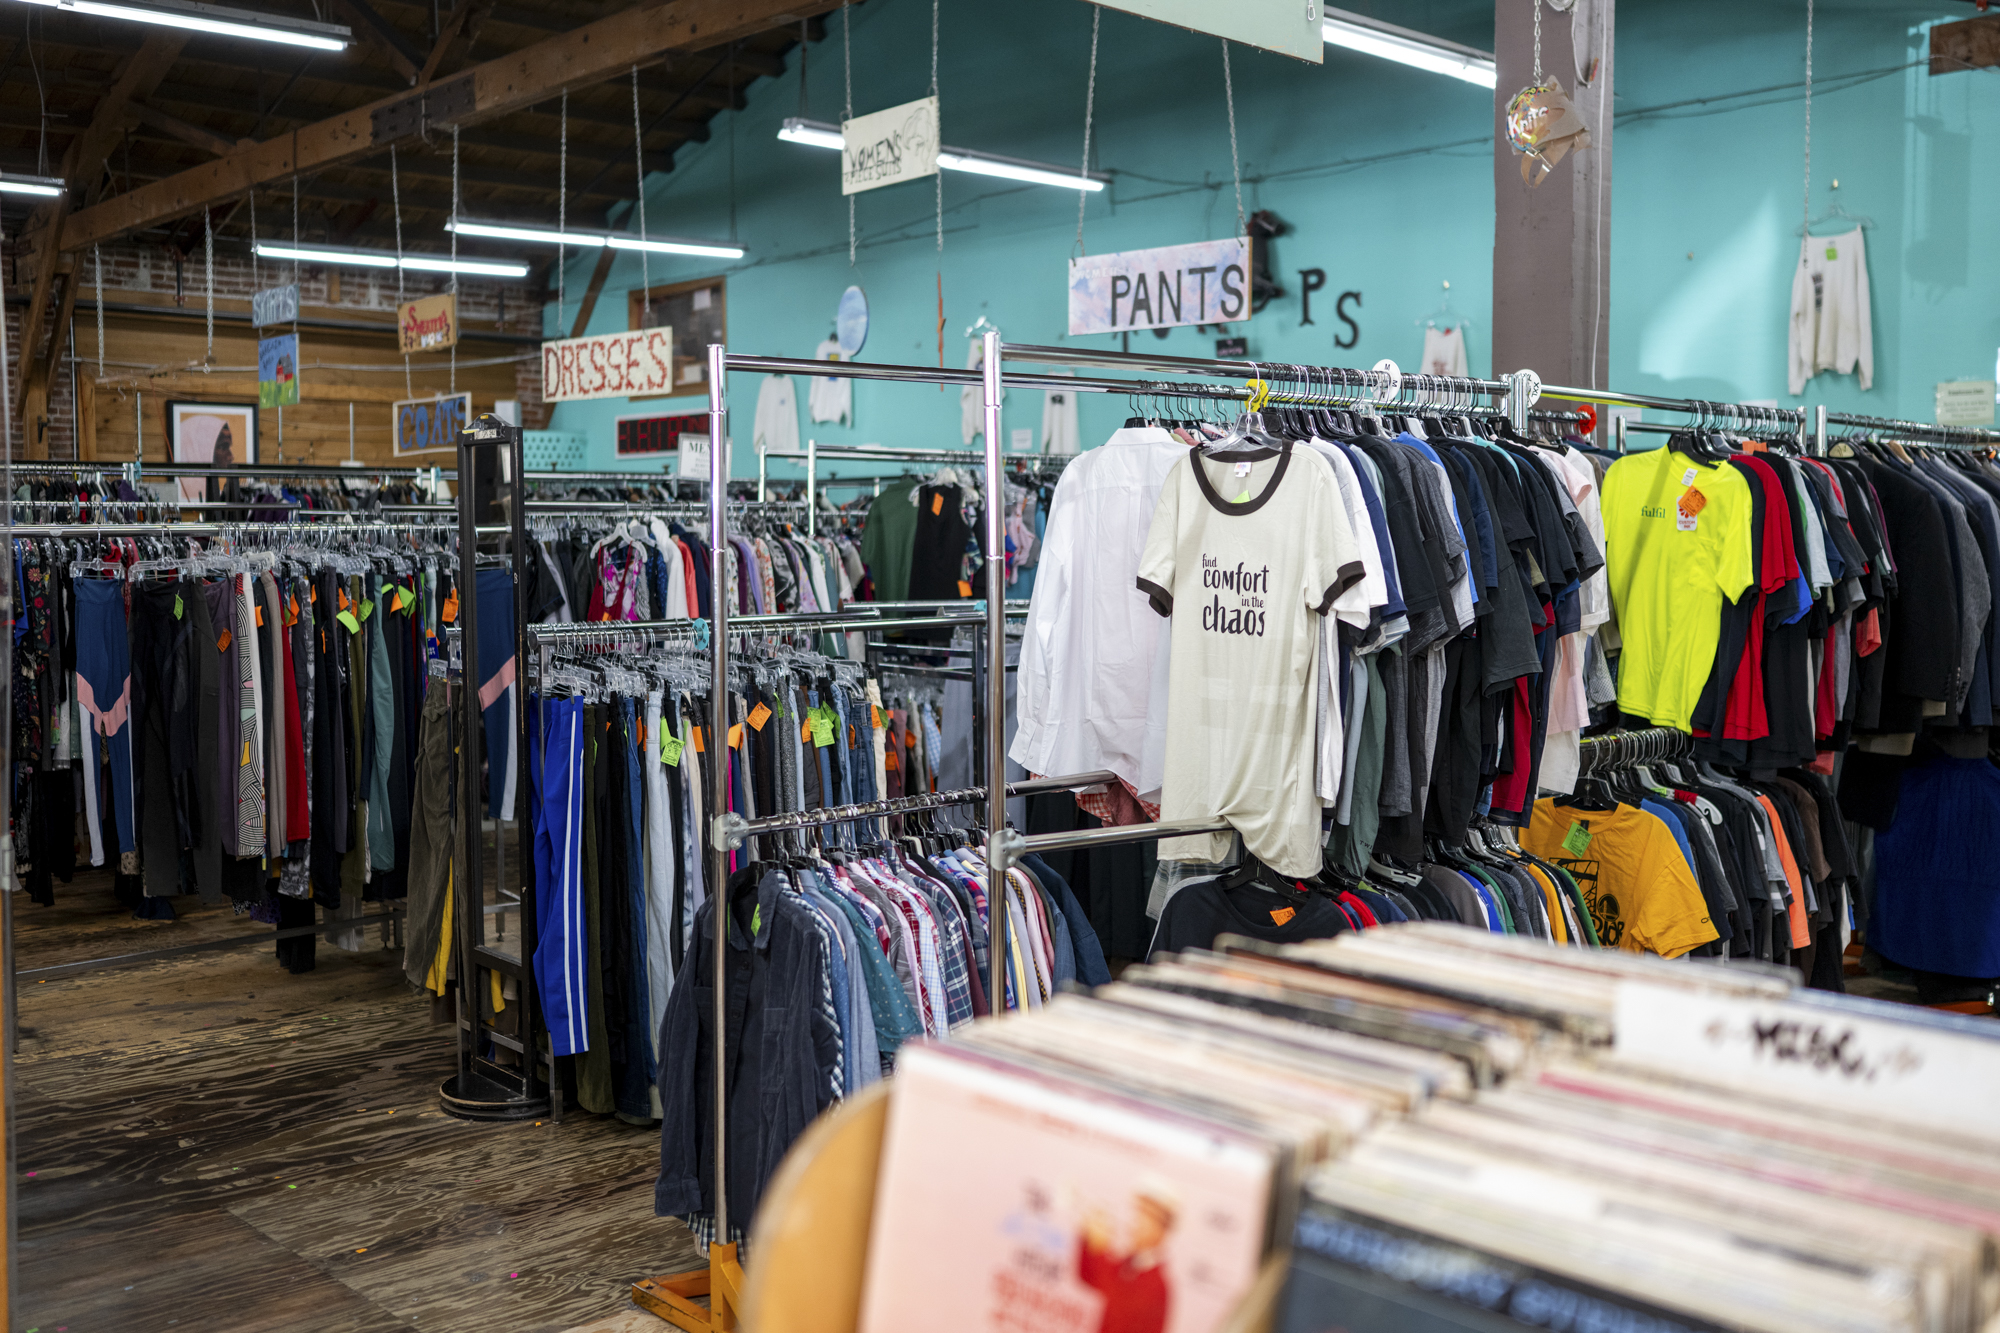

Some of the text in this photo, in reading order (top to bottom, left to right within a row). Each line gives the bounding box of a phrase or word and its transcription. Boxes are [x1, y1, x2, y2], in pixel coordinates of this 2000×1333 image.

[1110, 264, 1245, 327] PANTS
[544, 331, 668, 398] DRESSES
[399, 396, 467, 450] COATS
[1641, 505, 1666, 519] fulfil
[1202, 553, 1217, 569] find
[1203, 561, 1270, 596] comfort
[1202, 593, 1266, 638] chaos
[1241, 594, 1265, 609] in the
